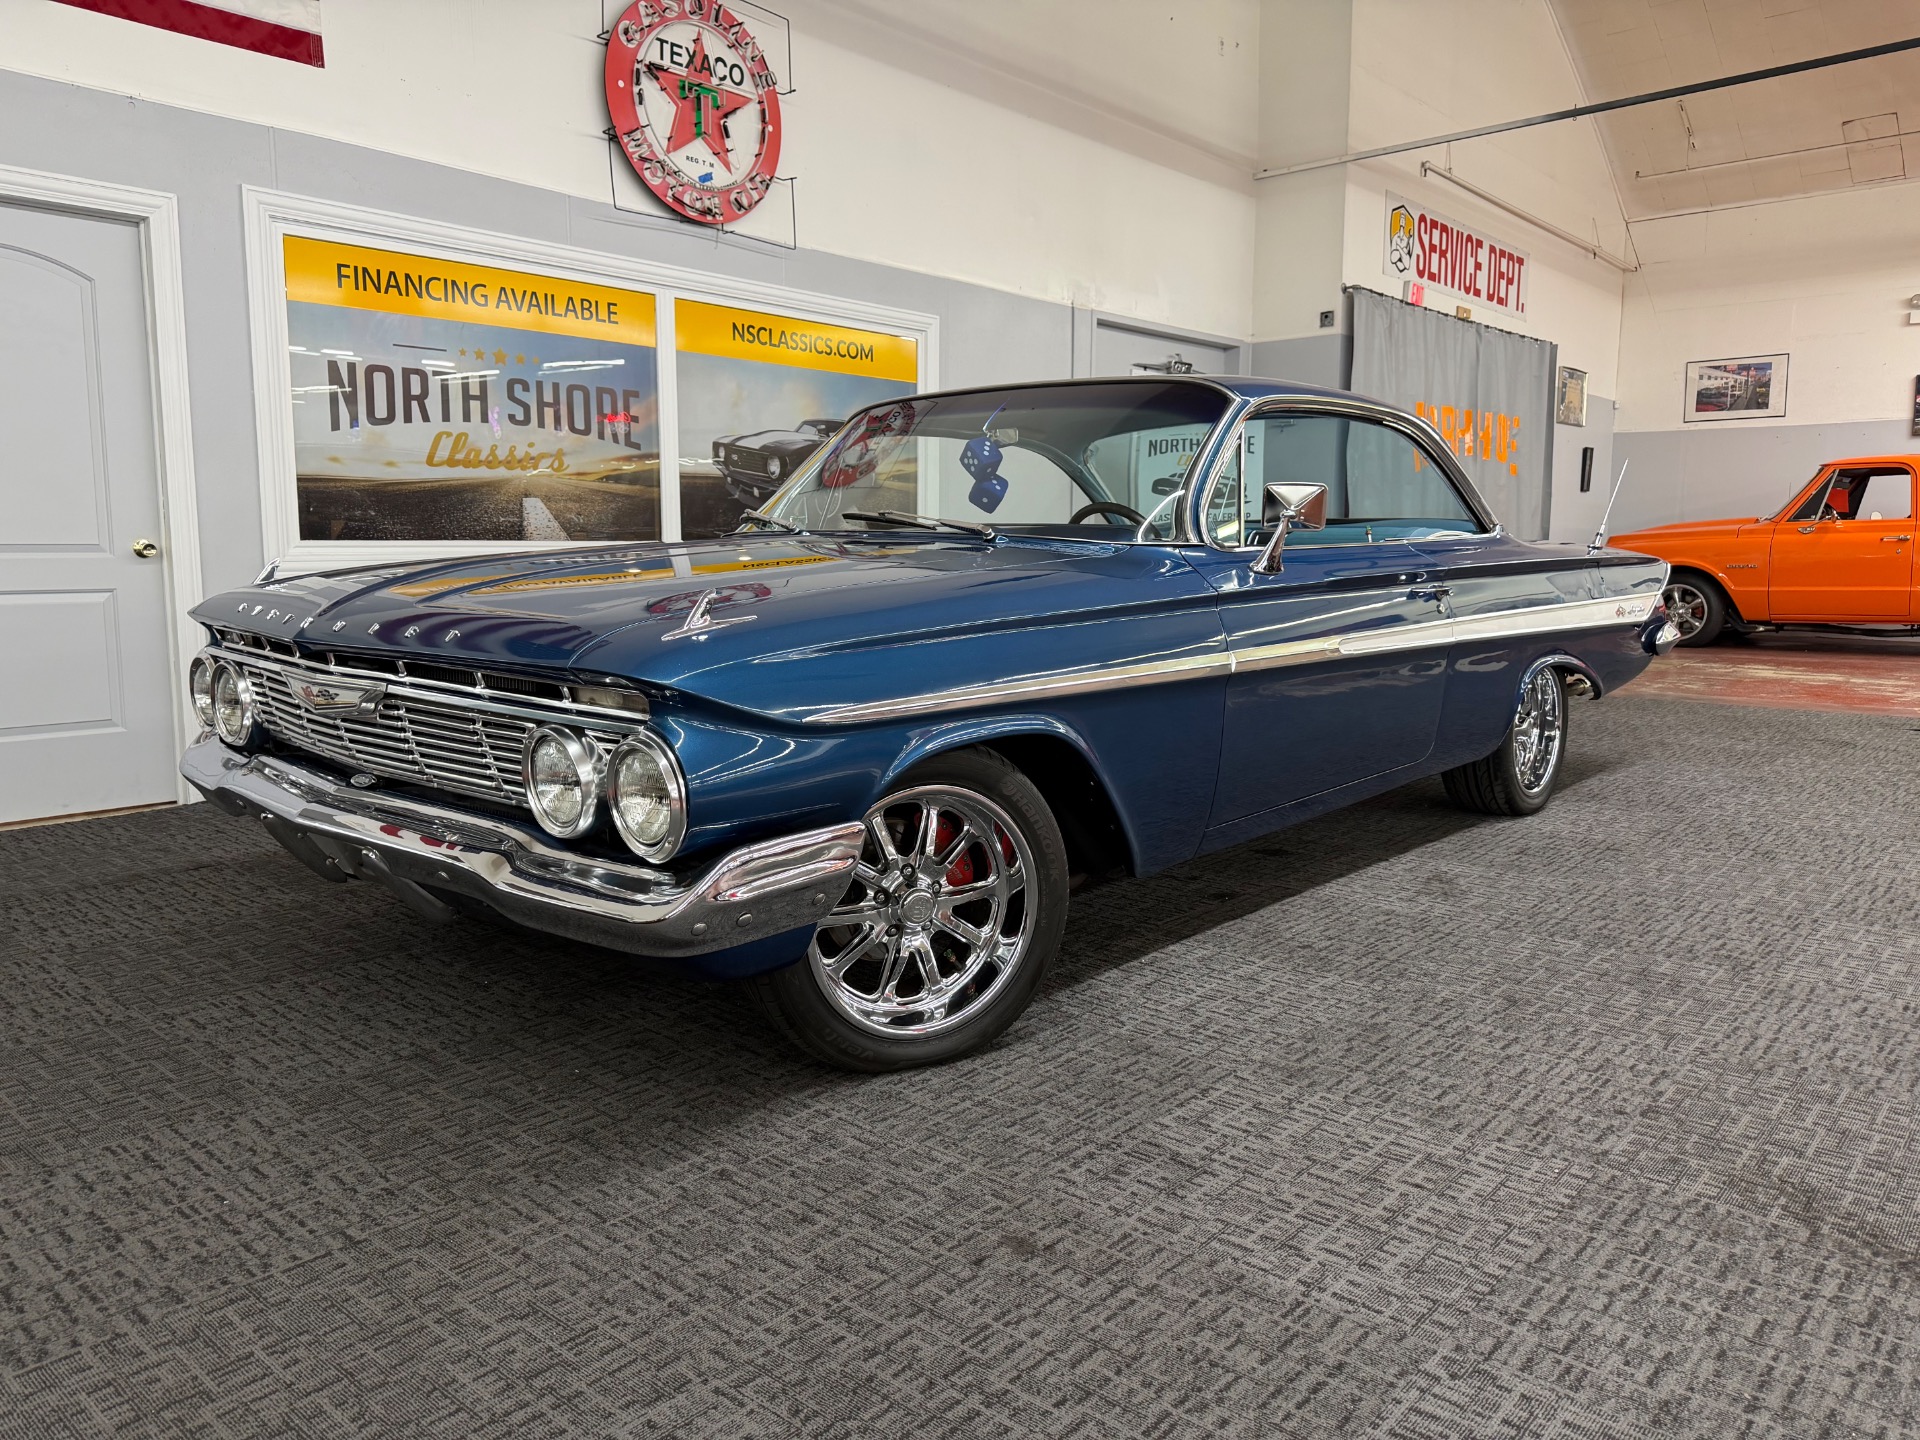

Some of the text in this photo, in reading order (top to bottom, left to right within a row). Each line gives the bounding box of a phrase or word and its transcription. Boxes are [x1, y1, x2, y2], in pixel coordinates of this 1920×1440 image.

[656, 37, 744, 87] TEXACO
[1415, 213, 1525, 313] SERVICE DEPT.
[336, 263, 619, 325] FINANCING AVAILABLE
[732, 322, 874, 362] NSCLASSICS.COM
[327, 359, 642, 451] NORTH SHORE
[425, 430, 570, 473] Classics
[1148, 437, 1200, 458] NORTH
